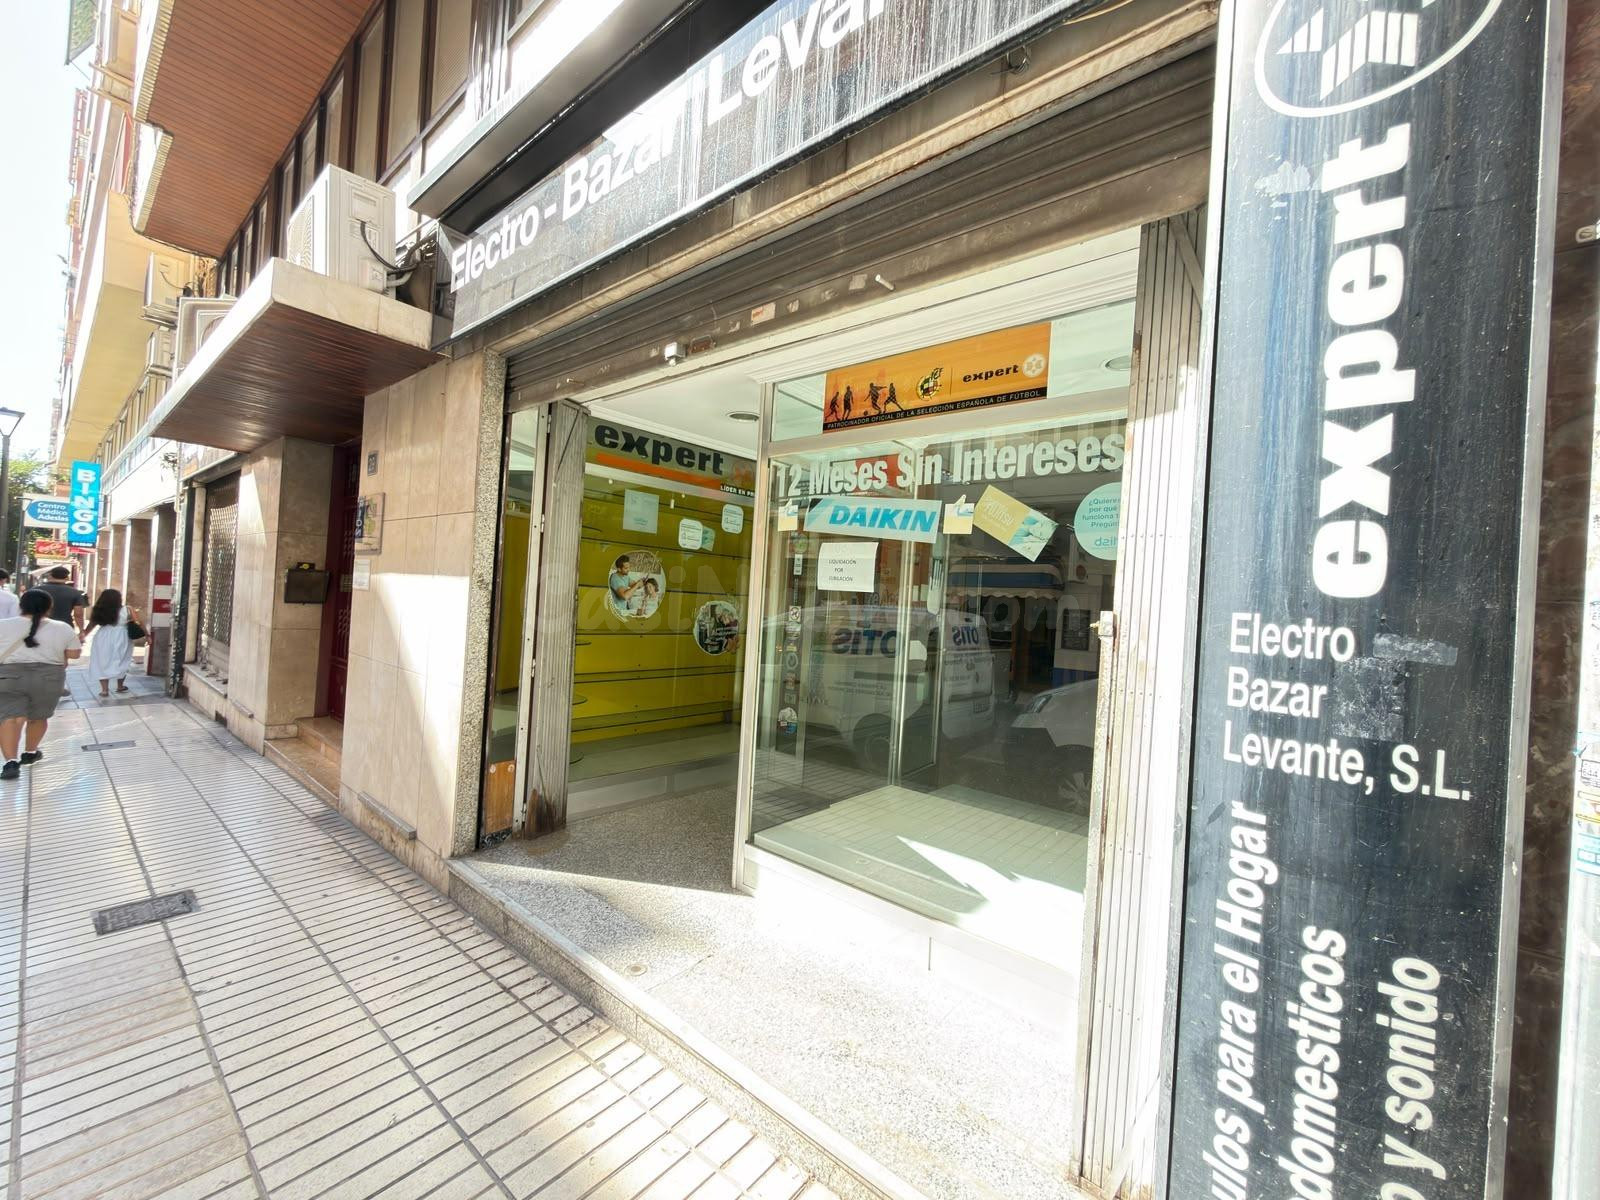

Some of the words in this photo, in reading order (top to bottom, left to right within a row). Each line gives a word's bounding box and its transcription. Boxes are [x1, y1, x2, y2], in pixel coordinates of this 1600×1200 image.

[450, 206, 539, 293] Electro
[563, 112, 688, 221] Bazar
[706, 0, 886, 127] Leva
[962, 364, 1018, 383] expert
[1312, 122, 1416, 599] expert
[827, 417, 870, 429] PATROCINADOR
[871, 413, 894, 423] OFICIAL
[916, 403, 954, 415] SELECCIÓN
[956, 397, 994, 409] ESPAÑOLA
[996, 395, 1007, 403] DE
[1009, 389, 1041, 400] FÚTBOL
[594, 423, 724, 476] expert
[776, 463, 800, 498] 12
[809, 460, 888, 495] Meses
[896, 449, 943, 488] Sin
[952, 433, 1124, 484] Intereses
[37, 502, 66, 510] Centro
[71, 468, 97, 535] BINGO
[829, 505, 937, 533] DAIKIN
[1229, 612, 1355, 662] Electro
[1226, 666, 1327, 719] Bazar
[1223, 720, 1375, 795] Levante,
[1390, 744, 1472, 801] S.L.
[1214, 800, 1279, 944] Hogar
[1214, 942, 1260, 994] el
[1216, 999, 1265, 1115] para
[1278, 925, 1347, 1200] domesticos
[1376, 957, 1441, 1131] sonido
[1383, 1134, 1446, 1180] y
